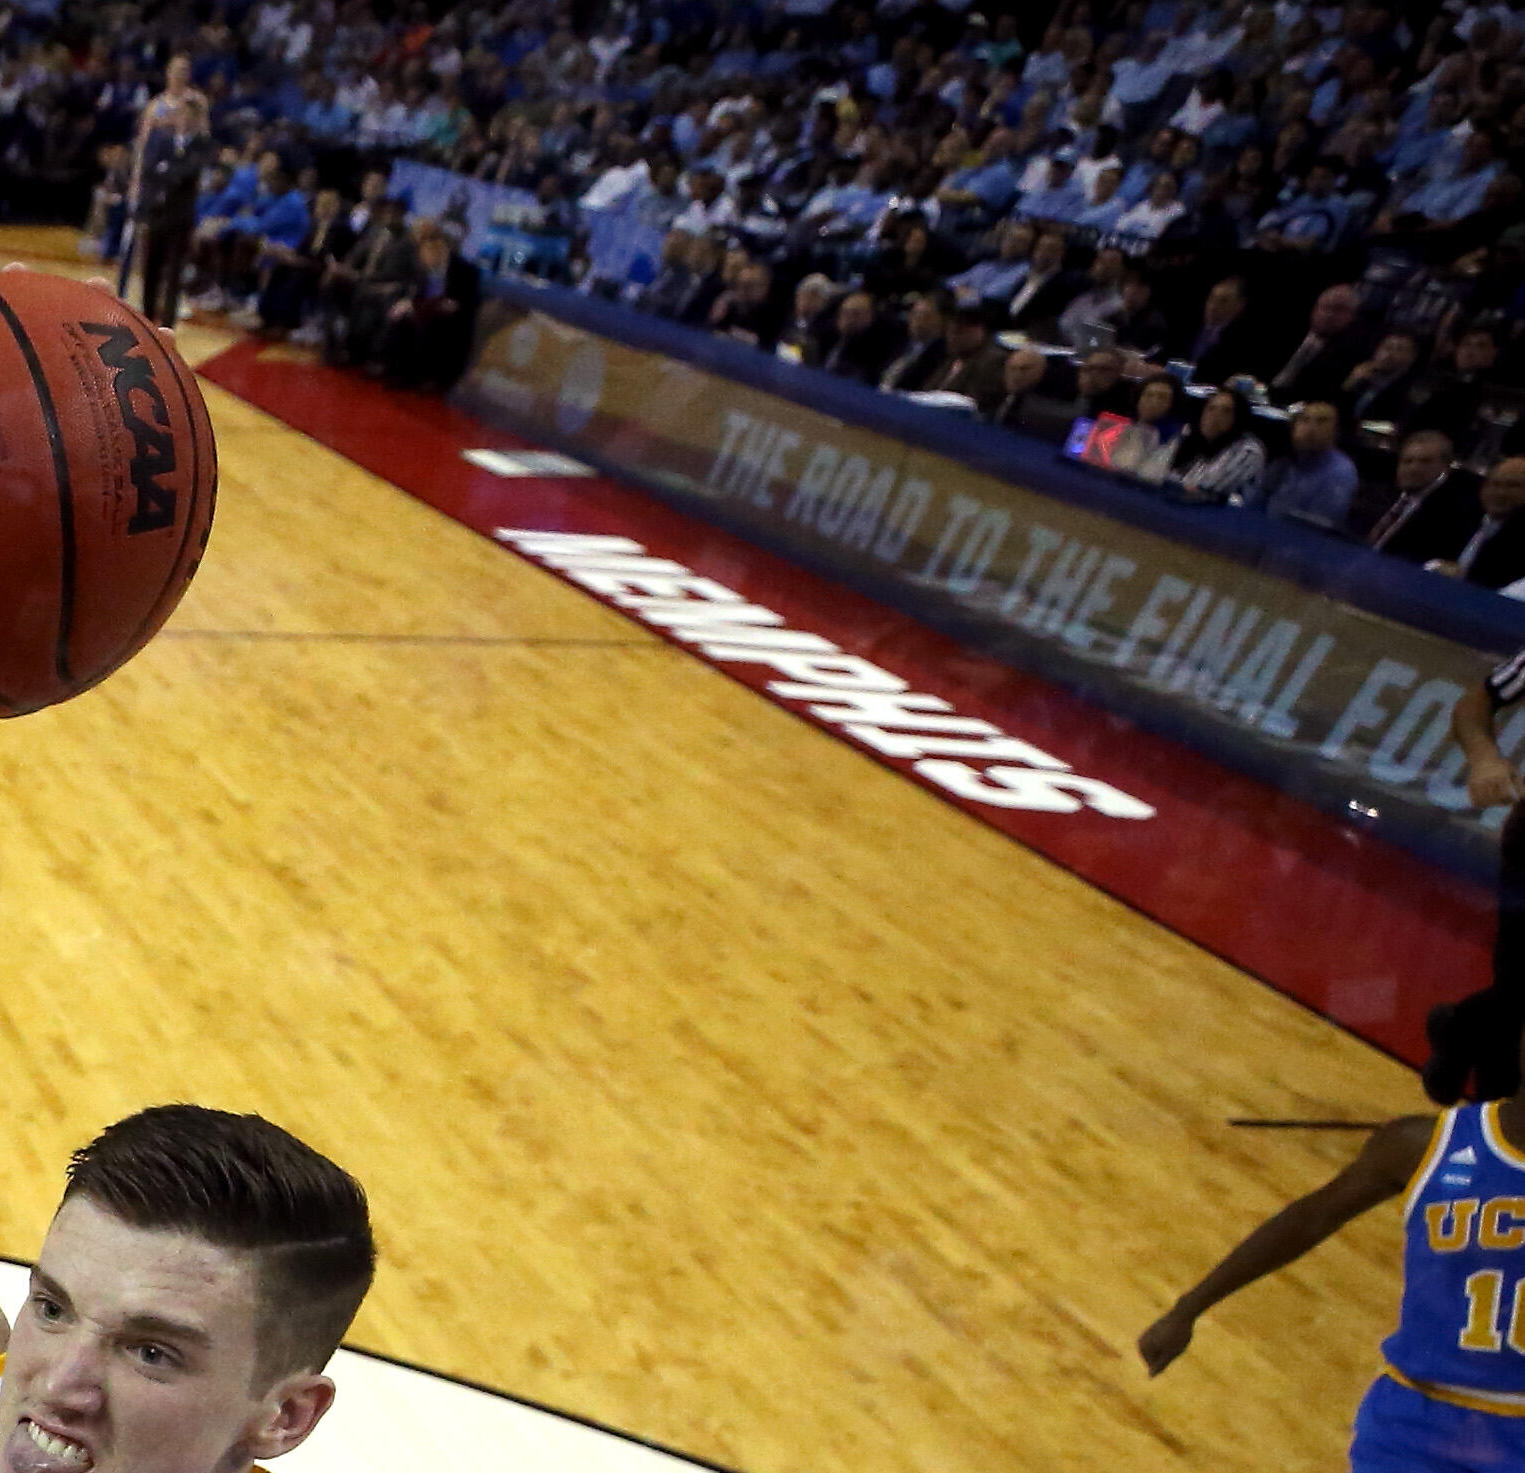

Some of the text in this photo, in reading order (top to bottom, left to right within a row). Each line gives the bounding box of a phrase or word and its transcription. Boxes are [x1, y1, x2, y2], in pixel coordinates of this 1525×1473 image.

[79, 320, 177, 537] NCAA
[707, 408, 802, 508] THE
[786, 444, 935, 563] ROAD
[923, 494, 1012, 595] TO
[999, 526, 1138, 648] THE
[1113, 573, 1335, 740] FINAL
[495, 525, 1156, 820] MEMPHIS
